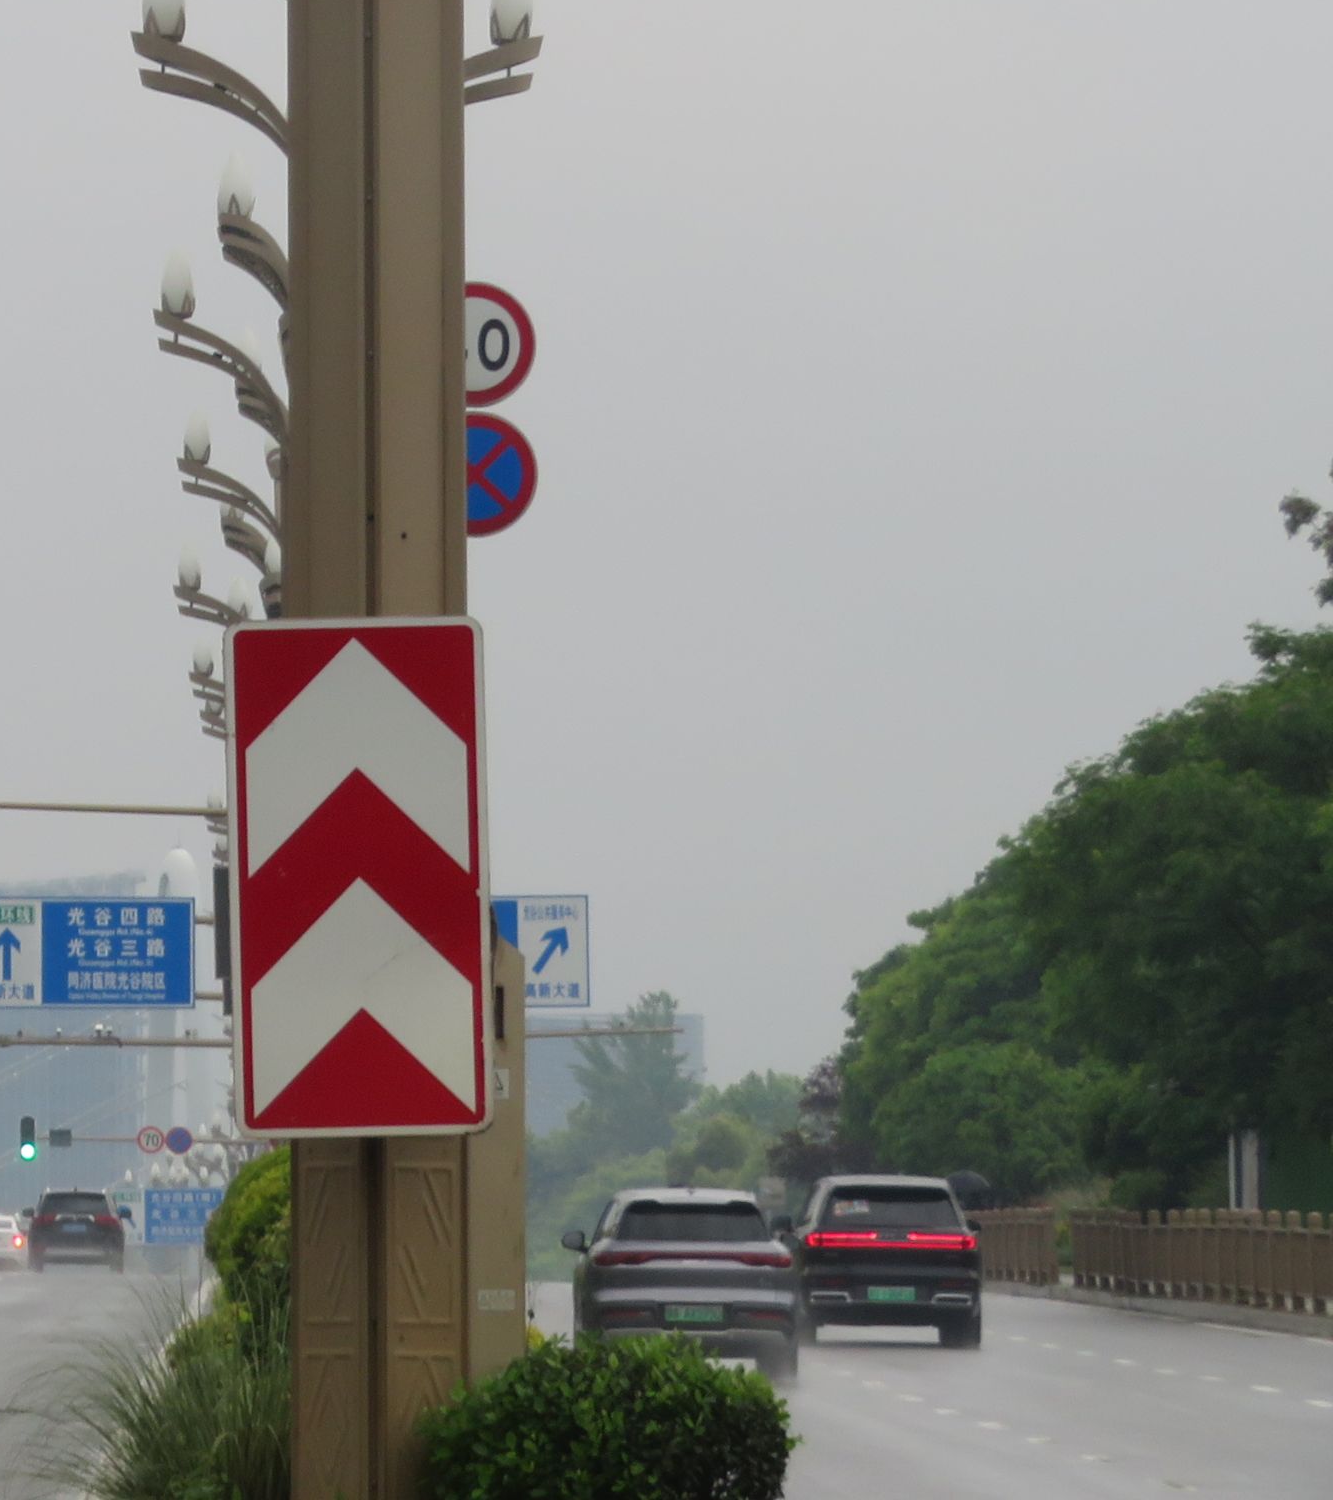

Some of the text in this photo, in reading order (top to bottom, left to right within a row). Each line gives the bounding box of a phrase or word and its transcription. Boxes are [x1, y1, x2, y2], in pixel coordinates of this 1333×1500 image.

[68, 907, 165, 926] 光谷四路
[68, 938, 165, 957] 光谷三路
[144, 1133, 159, 1147] 70
